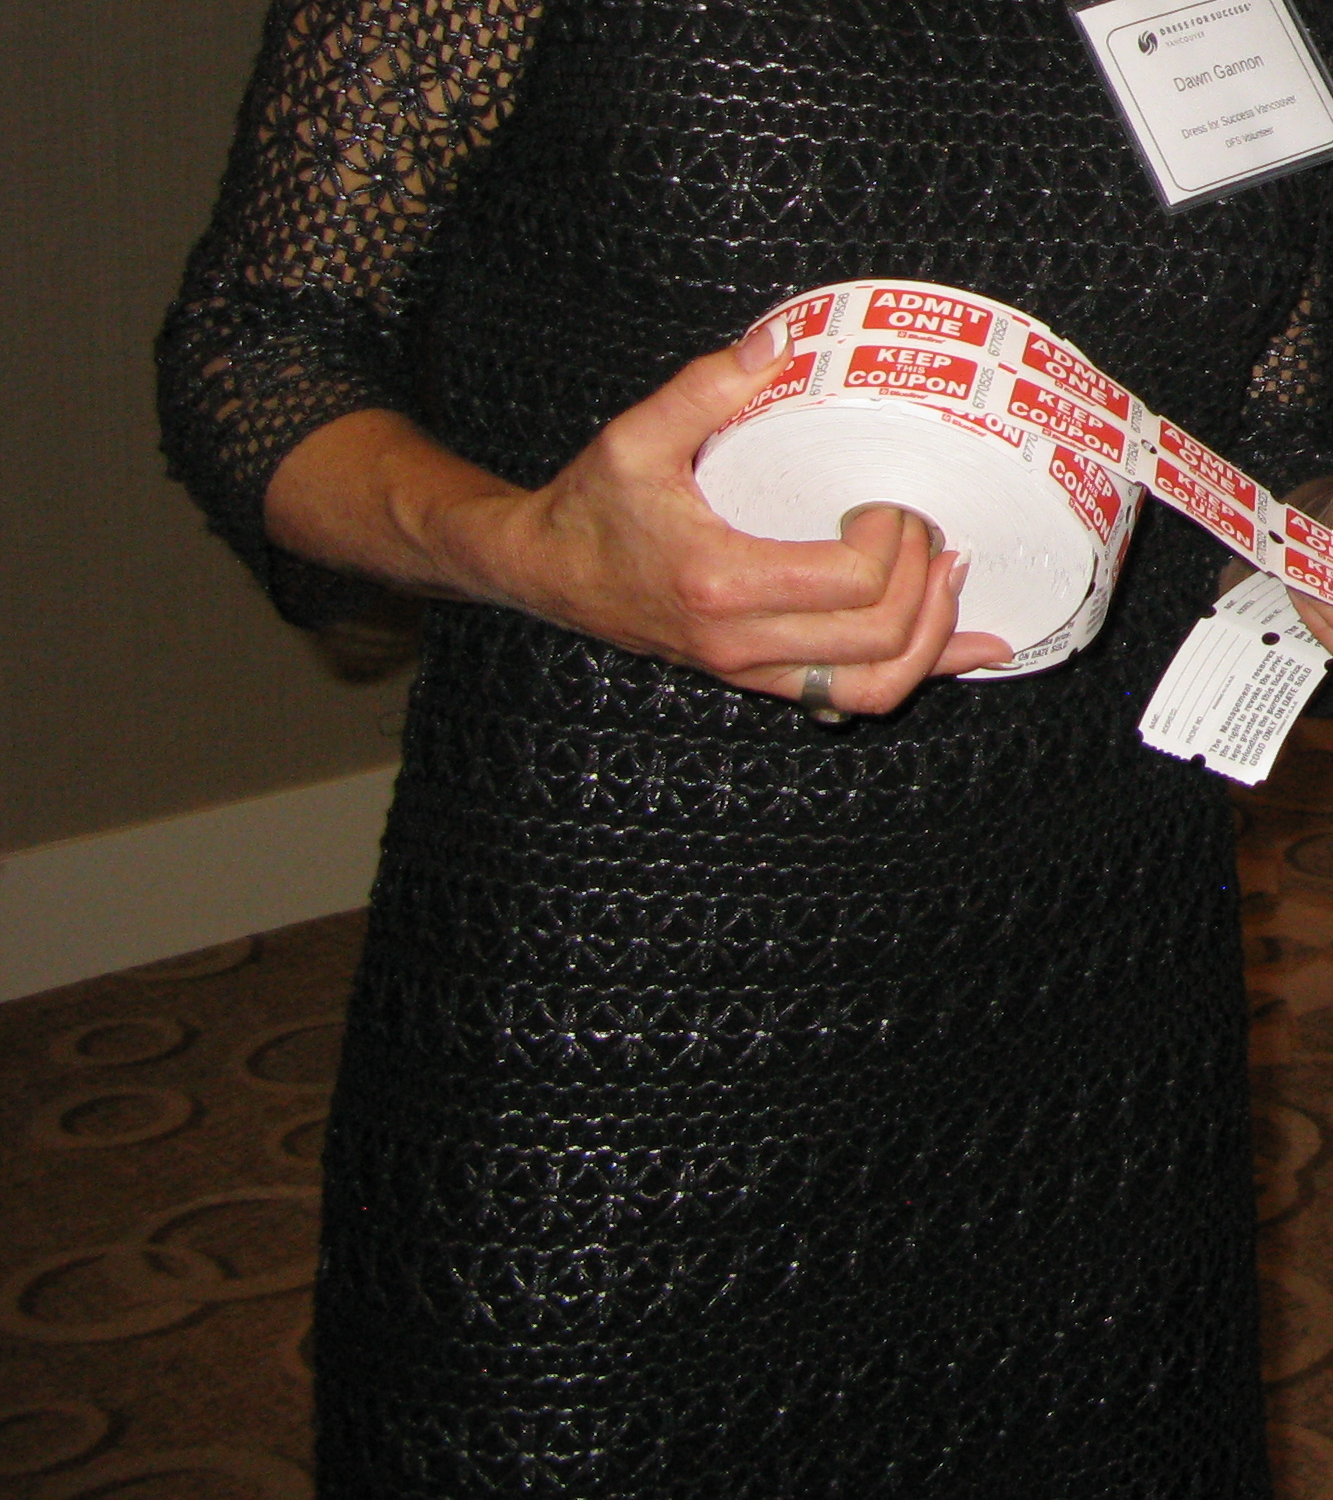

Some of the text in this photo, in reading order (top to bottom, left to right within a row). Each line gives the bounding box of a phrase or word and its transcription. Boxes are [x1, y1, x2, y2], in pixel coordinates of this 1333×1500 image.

[1160, 3, 1248, 35] DRESS FOR SUCCESS
[1173, 53, 1264, 91] Dawn Gannon
[1181, 95, 1296, 138] Dress for Success Vancouver
[780, 298, 829, 322] MIT
[874, 293, 987, 323] ADMIT
[888, 311, 963, 336] ONE
[877, 349, 952, 368] KEEP
[896, 364, 925, 374] THIS
[1032, 340, 1125, 400] ADMIT
[848, 371, 967, 397] COUPON
[972, 367, 994, 409] 6770525
[1045, 362, 1108, 405] ONE
[1038, 390, 1103, 429] KEEP
[1056, 411, 1083, 428] THIS
[1011, 402, 1119, 460] COUPON
[1022, 432, 1038, 462] 6770
[1074, 454, 1113, 497] KEEP
[1165, 428, 1251, 490] ADMIT
[1179, 448, 1235, 495] ONE
[1052, 460, 1110, 541] COUPON
[1083, 475, 1099, 498] THIS
[1177, 472, 1235, 517] KEEP
[1158, 477, 1251, 548] COUPON
[1219, 682, 1253, 733] Management
[1248, 742, 1266, 766] GOOD
[1262, 720, 1277, 740] ONLY
[1274, 707, 1284, 719] ON
[1282, 687, 1297, 706] DATE
[1294, 666, 1311, 687] SOLD
